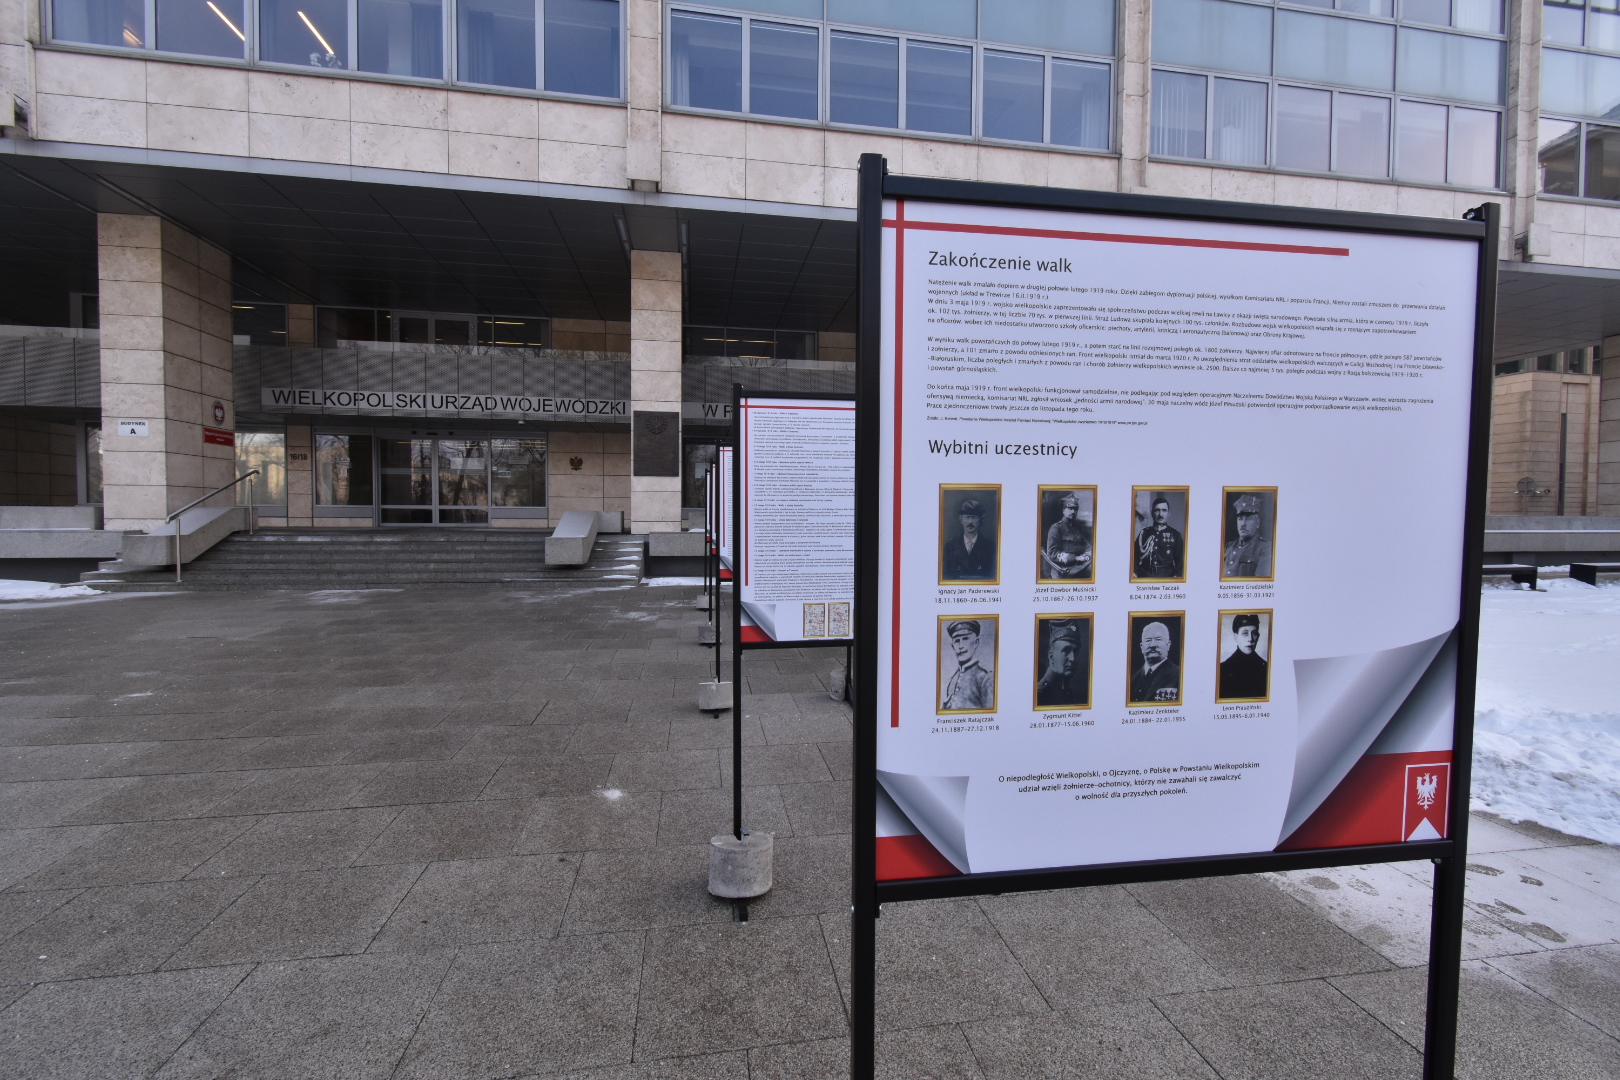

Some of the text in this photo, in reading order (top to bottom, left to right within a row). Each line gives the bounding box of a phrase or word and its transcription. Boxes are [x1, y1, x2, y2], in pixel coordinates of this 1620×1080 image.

[928, 250, 1072, 273] Zakończenie walk
[272, 390, 626, 414] WIELKOPOLSKI URZĄD WOJEWÓDZKI
[928, 439, 1077, 459] Wybitni uczestnicy
[1006, 772, 1054, 782] niepodległość
[1055, 770, 1100, 779] Wielkopolski,
[1108, 769, 1141, 777] Ojczyznę,
[1179, 764, 1212, 772] Powstaniu
[1213, 761, 1259, 770] Wielkopolskim
[1018, 784, 1040, 792] udział
[1041, 783, 1061, 791] wzięli
[1062, 780, 1132, 790] żołnierze-ochotnicy,
[1134, 778, 1155, 786] którzy
[1168, 775, 1196, 784] zawahali
[1209, 772, 1241, 782] zawalczyć
[1081, 791, 1108, 800] wolność
[1122, 788, 1158, 799] przyszłych
[1159, 786, 1188, 796] pokoleń.
